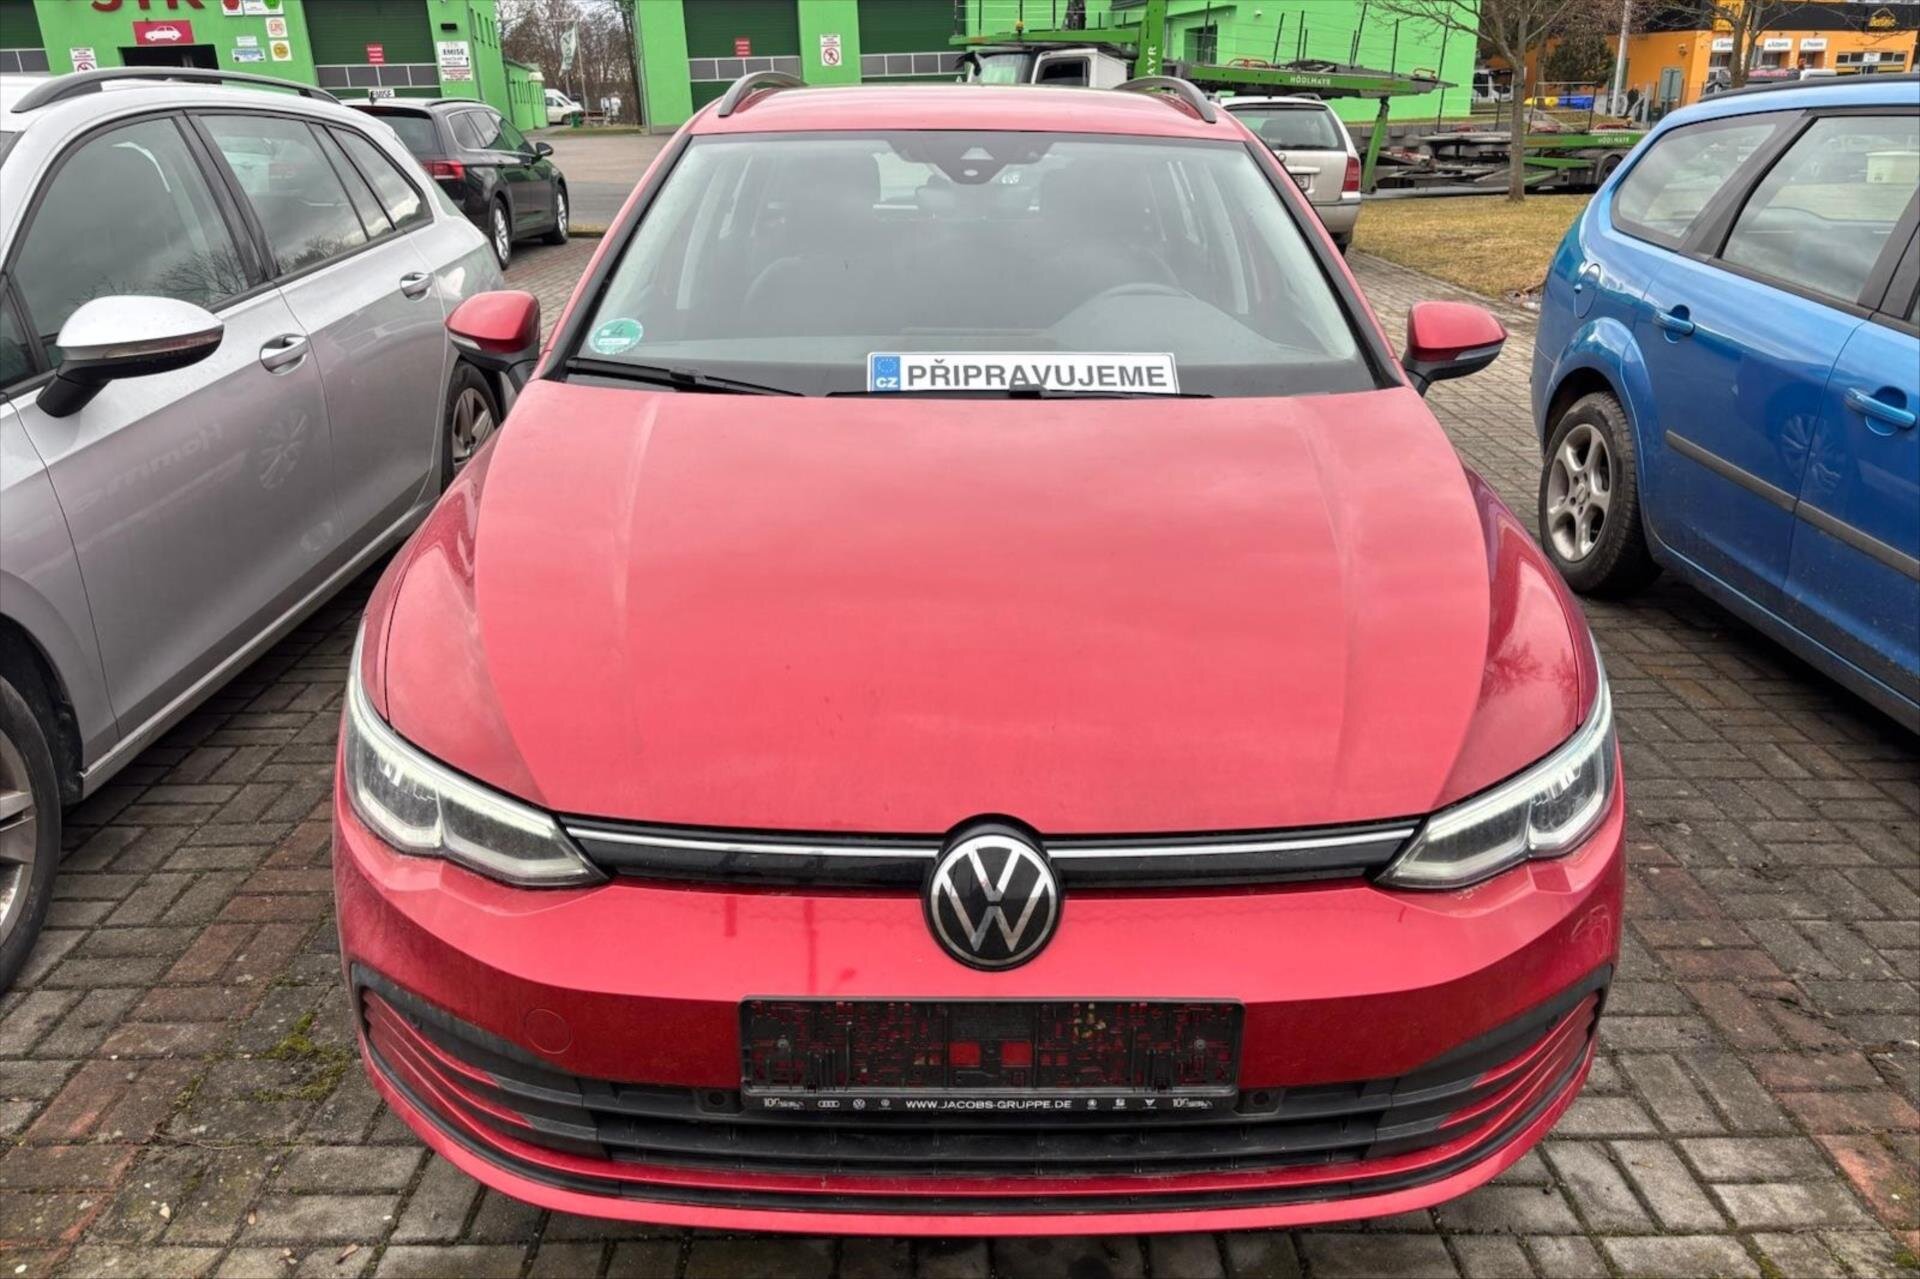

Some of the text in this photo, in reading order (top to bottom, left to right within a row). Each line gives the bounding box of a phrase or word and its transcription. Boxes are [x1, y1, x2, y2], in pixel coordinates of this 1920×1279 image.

[876, 358, 1167, 388] CZ PŘIPRAVUJEME
[905, 1099, 1073, 1110] WWW.JACOBS-GRUPPE.DE
